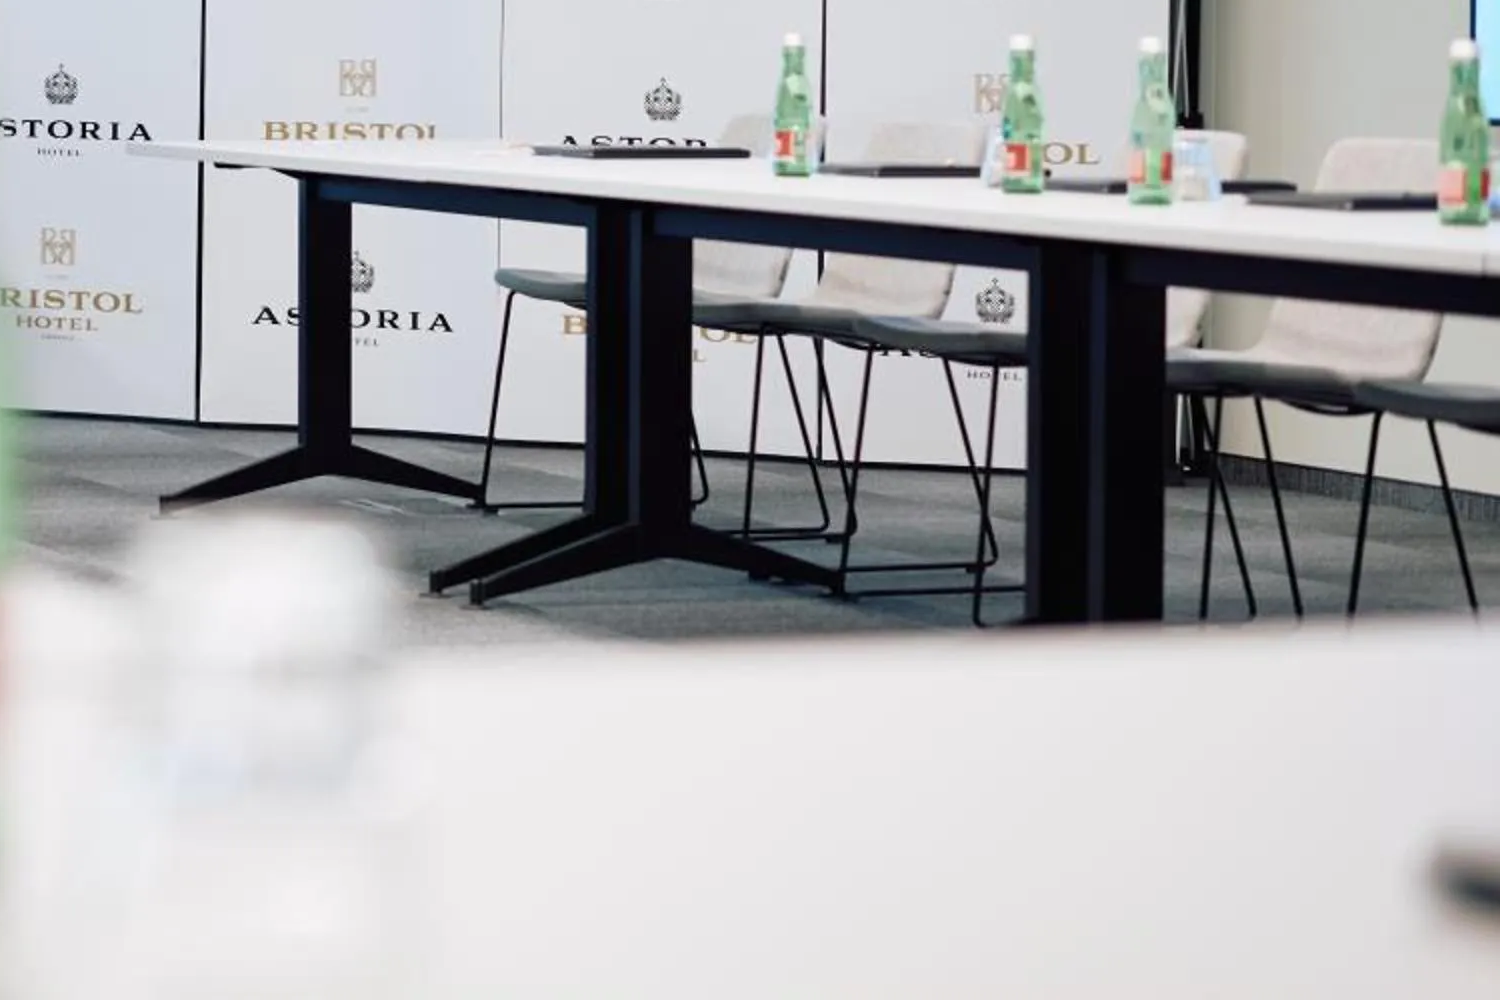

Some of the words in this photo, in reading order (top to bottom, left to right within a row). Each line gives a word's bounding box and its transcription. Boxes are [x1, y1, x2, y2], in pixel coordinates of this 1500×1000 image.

[16, 315, 98, 331] HOTEL
[252, 306, 454, 333] ASORIA
[967, 370, 1022, 381] HOEL
